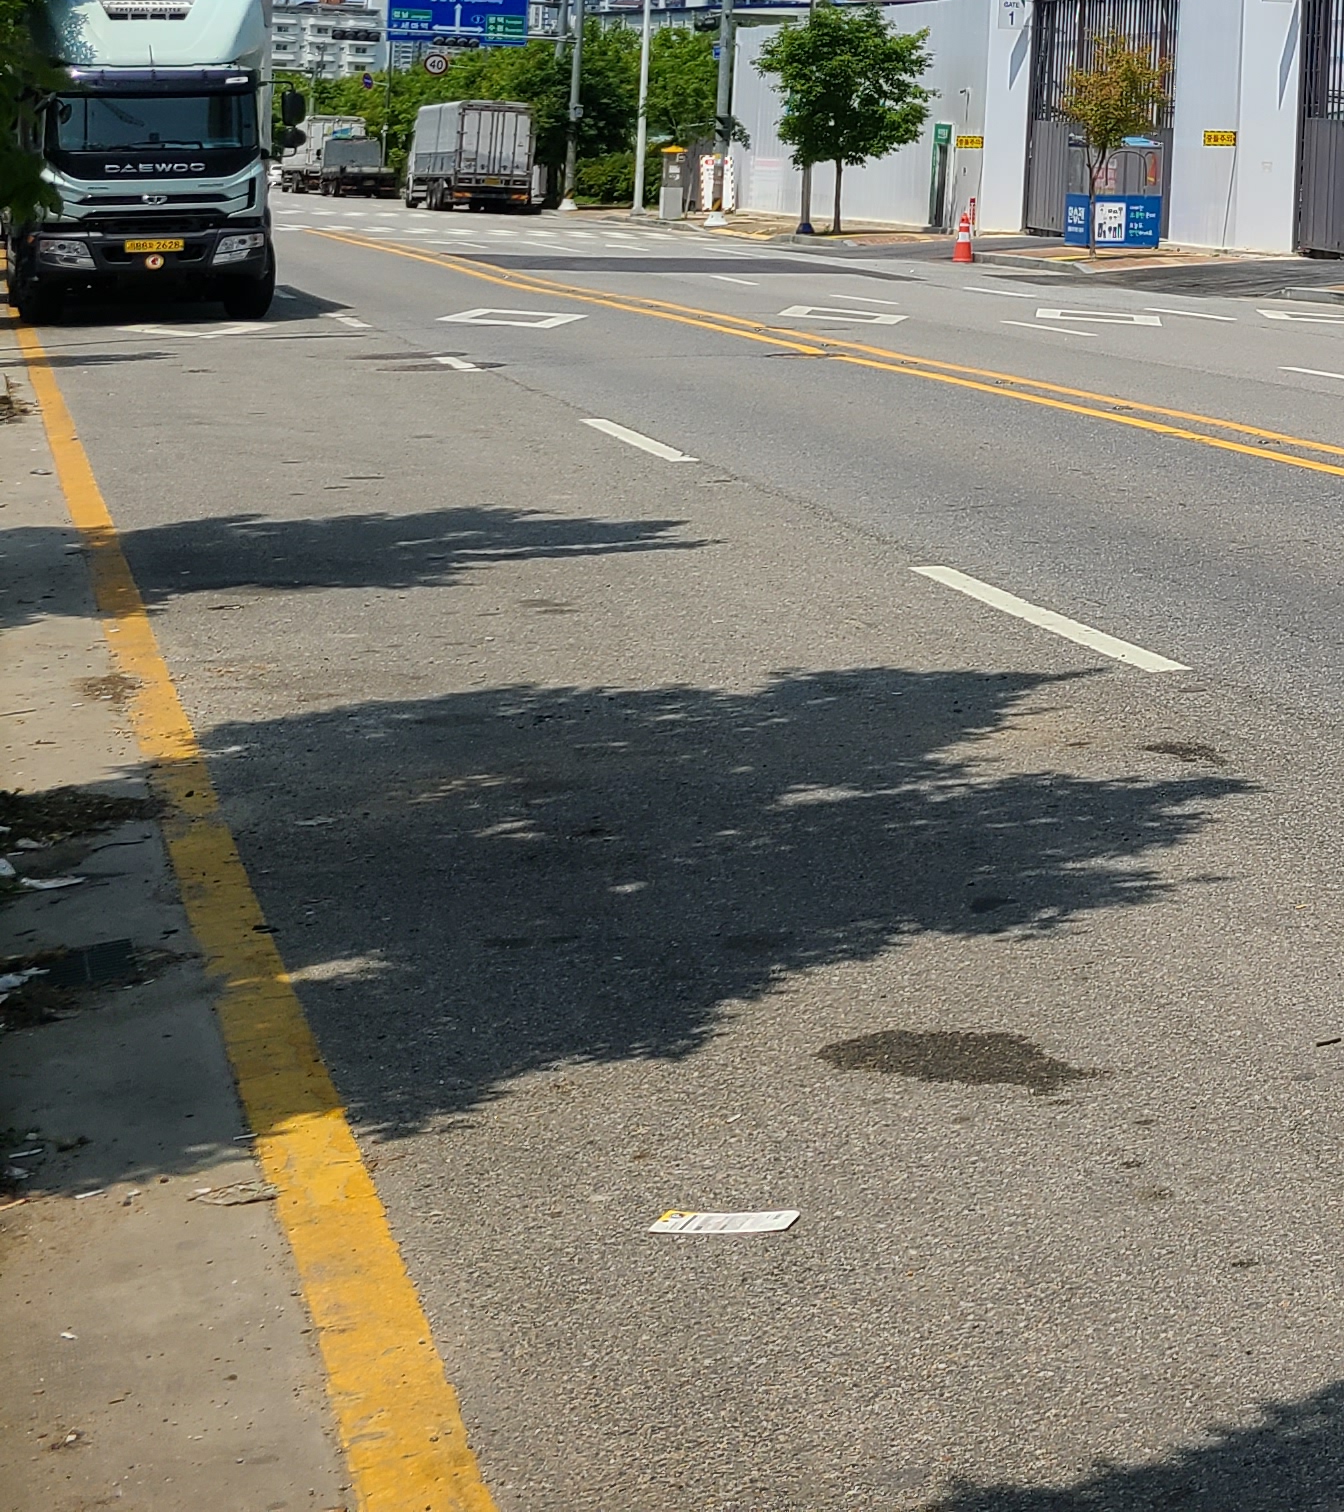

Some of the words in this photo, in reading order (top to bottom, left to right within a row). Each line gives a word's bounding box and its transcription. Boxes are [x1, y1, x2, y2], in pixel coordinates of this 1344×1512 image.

[1008, 11, 1014, 26] 1
[429, 59, 443, 70] 40
[105, 162, 206, 173] DAEWOO
